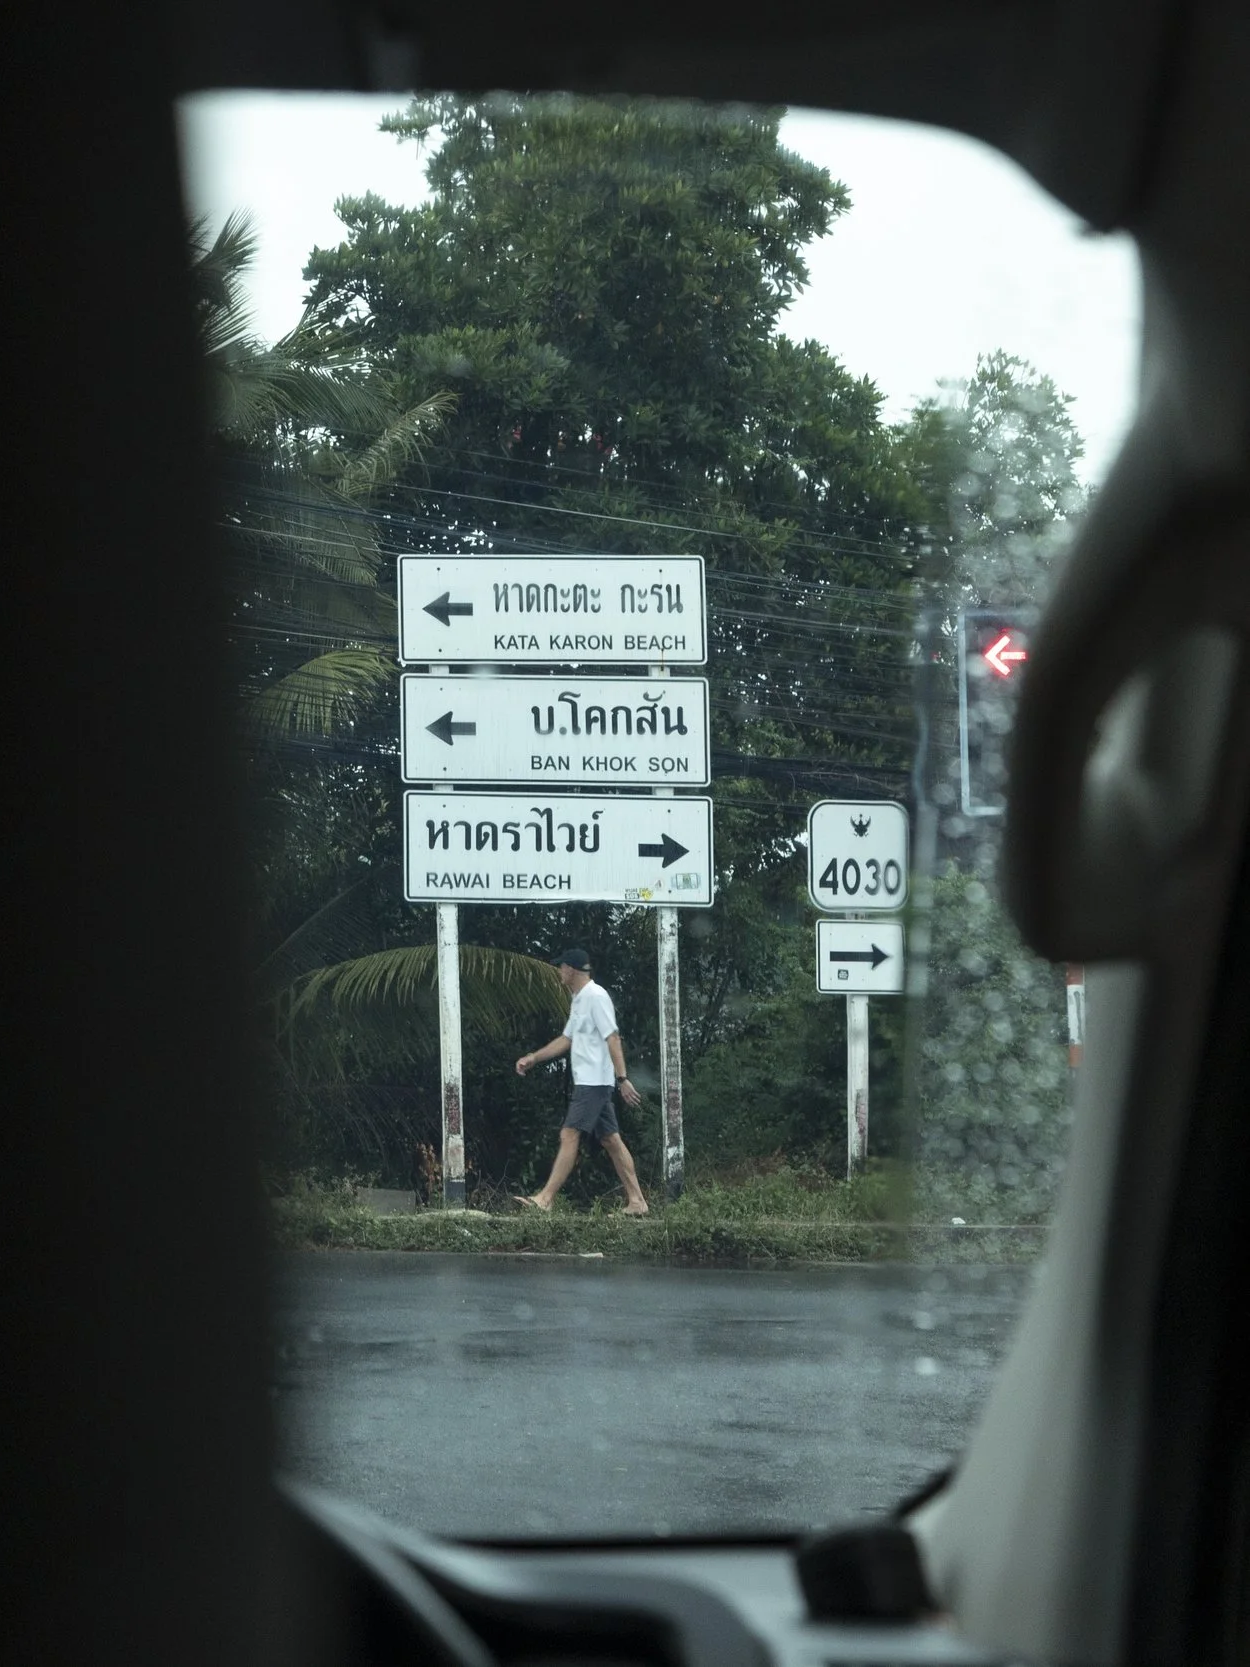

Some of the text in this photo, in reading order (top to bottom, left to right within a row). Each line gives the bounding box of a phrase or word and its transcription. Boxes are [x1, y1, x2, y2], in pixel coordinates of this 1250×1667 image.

[493, 583, 684, 614] หาดกะตะ กะรน
[494, 635, 686, 650] KATA KARON BEACH
[531, 690, 688, 735] บ.โคกสัน
[531, 755, 689, 773] BAN KHOK SON
[426, 807, 604, 853] หาดราไวย์
[426, 872, 571, 890] RAWAI BEACH
[819, 857, 901, 895] 4030
